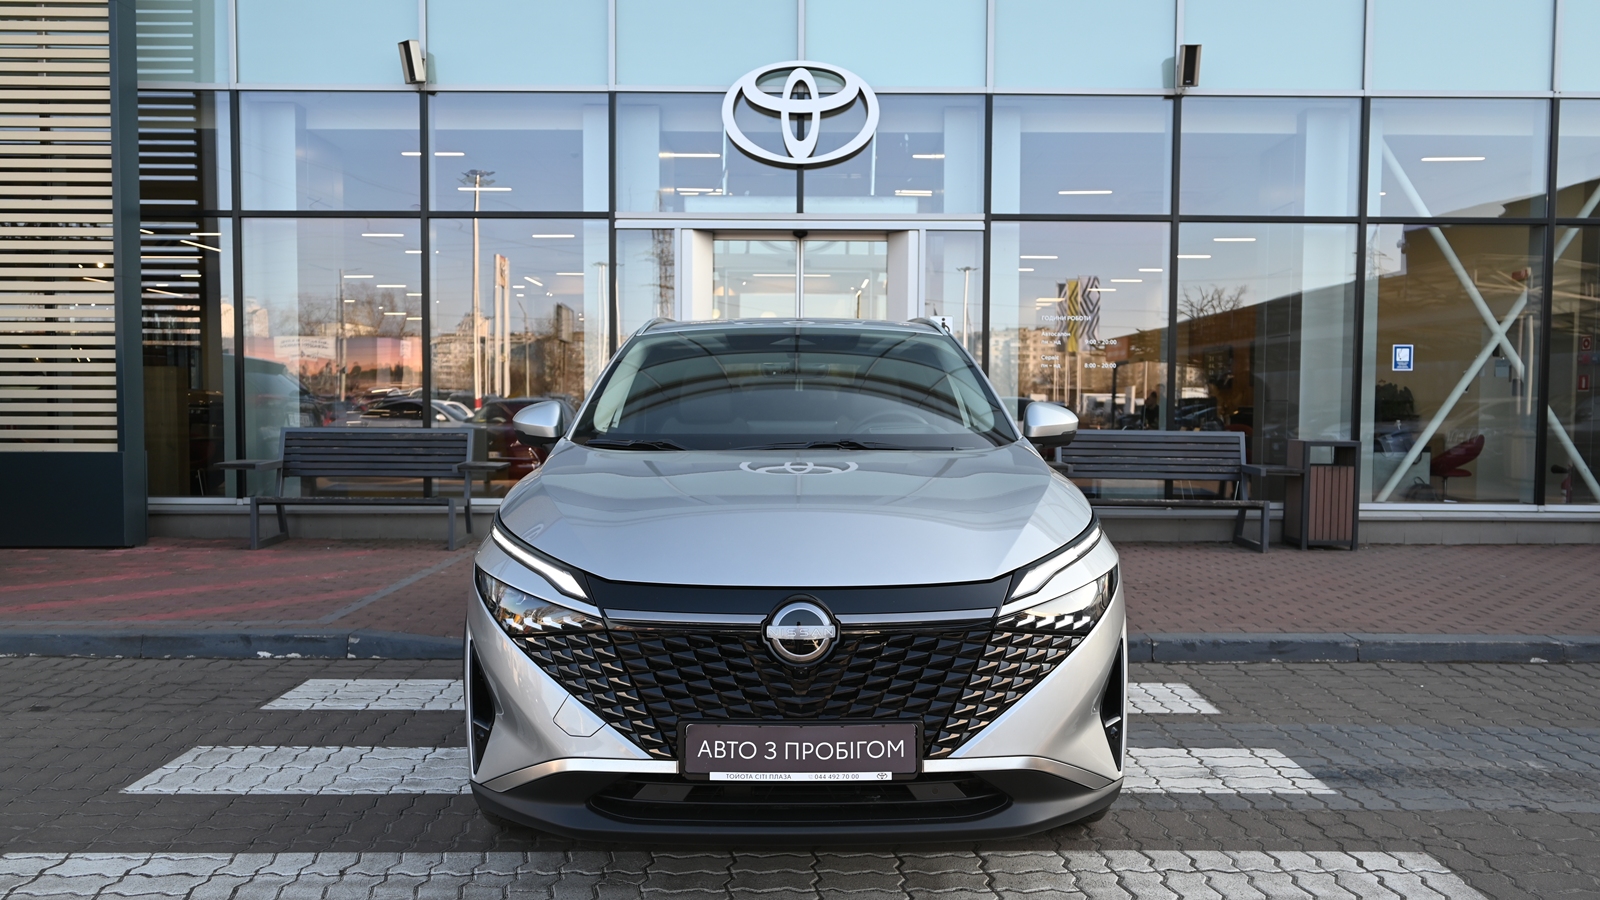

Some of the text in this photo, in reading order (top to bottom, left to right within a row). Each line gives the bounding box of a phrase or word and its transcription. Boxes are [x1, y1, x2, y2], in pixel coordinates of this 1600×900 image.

[768, 628, 834, 638] NISSAN
[697, 740, 757, 760] АВТО
[785, 739, 904, 760] ПРОБІГОМ
